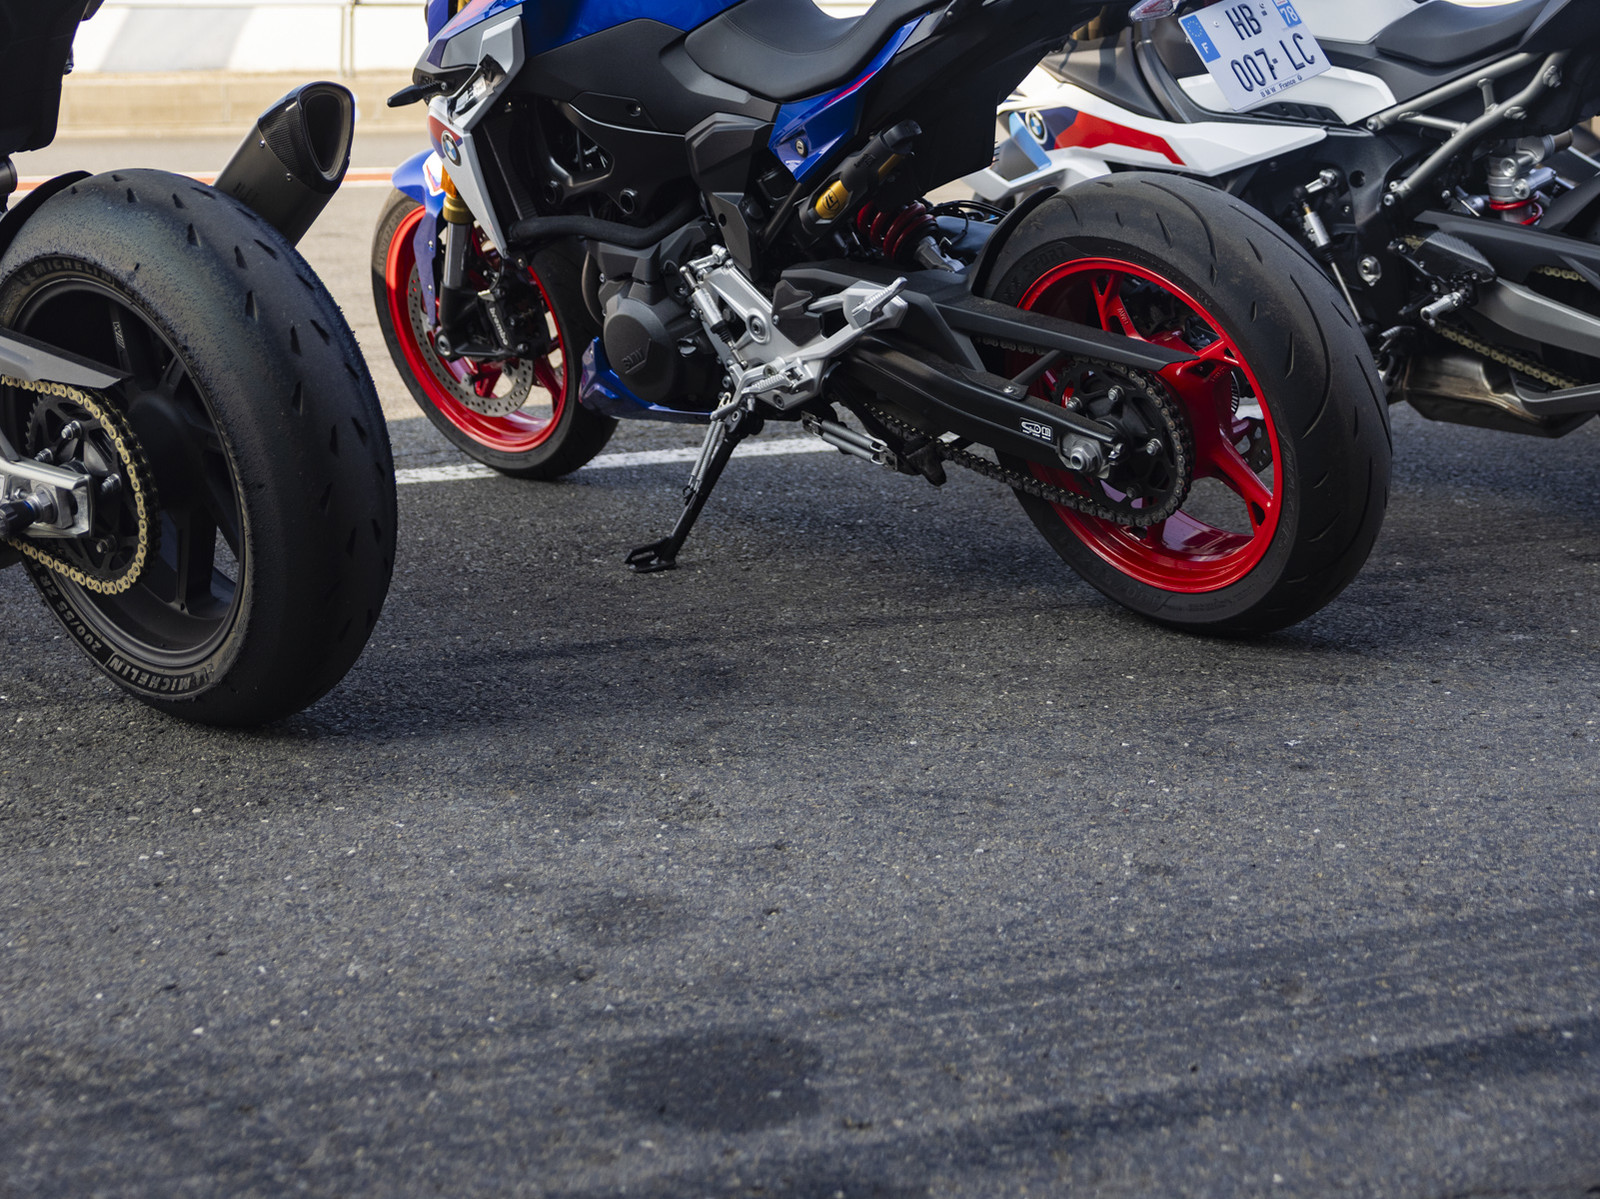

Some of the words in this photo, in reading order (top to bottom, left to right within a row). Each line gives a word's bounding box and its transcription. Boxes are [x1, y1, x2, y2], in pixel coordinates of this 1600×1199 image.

[1280, 8, 1298, 25] 78
[1201, 42, 1208, 54] F
[35, 259, 113, 283] MICHELIN
[40, 576, 58, 597] ZR
[56, 601, 102, 653] 200/55
[109, 656, 192, 691] MICHELIN
